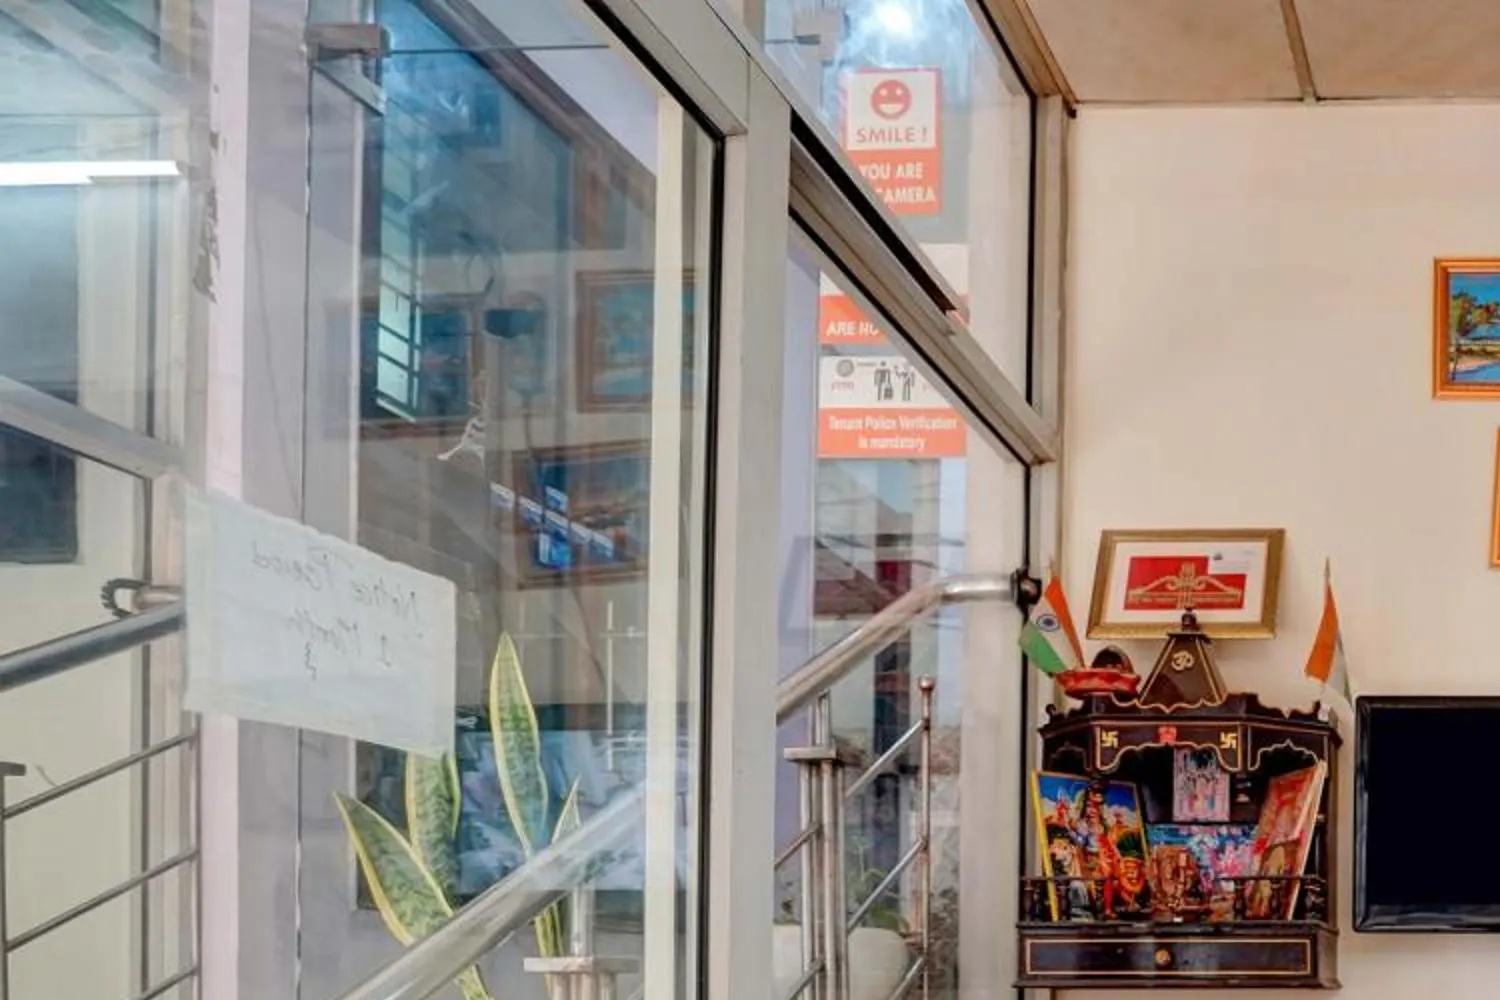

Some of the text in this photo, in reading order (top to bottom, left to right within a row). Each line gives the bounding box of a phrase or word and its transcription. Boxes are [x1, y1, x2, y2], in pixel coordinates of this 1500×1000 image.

[856, 126, 915, 143] SMILE
[857, 161, 923, 179] YOU ARE
[876, 186, 936, 203] AMERA
[826, 320, 854, 336] ARE
[829, 414, 957, 431] Tenant Police Verification
[868, 434, 926, 452] mandatory
